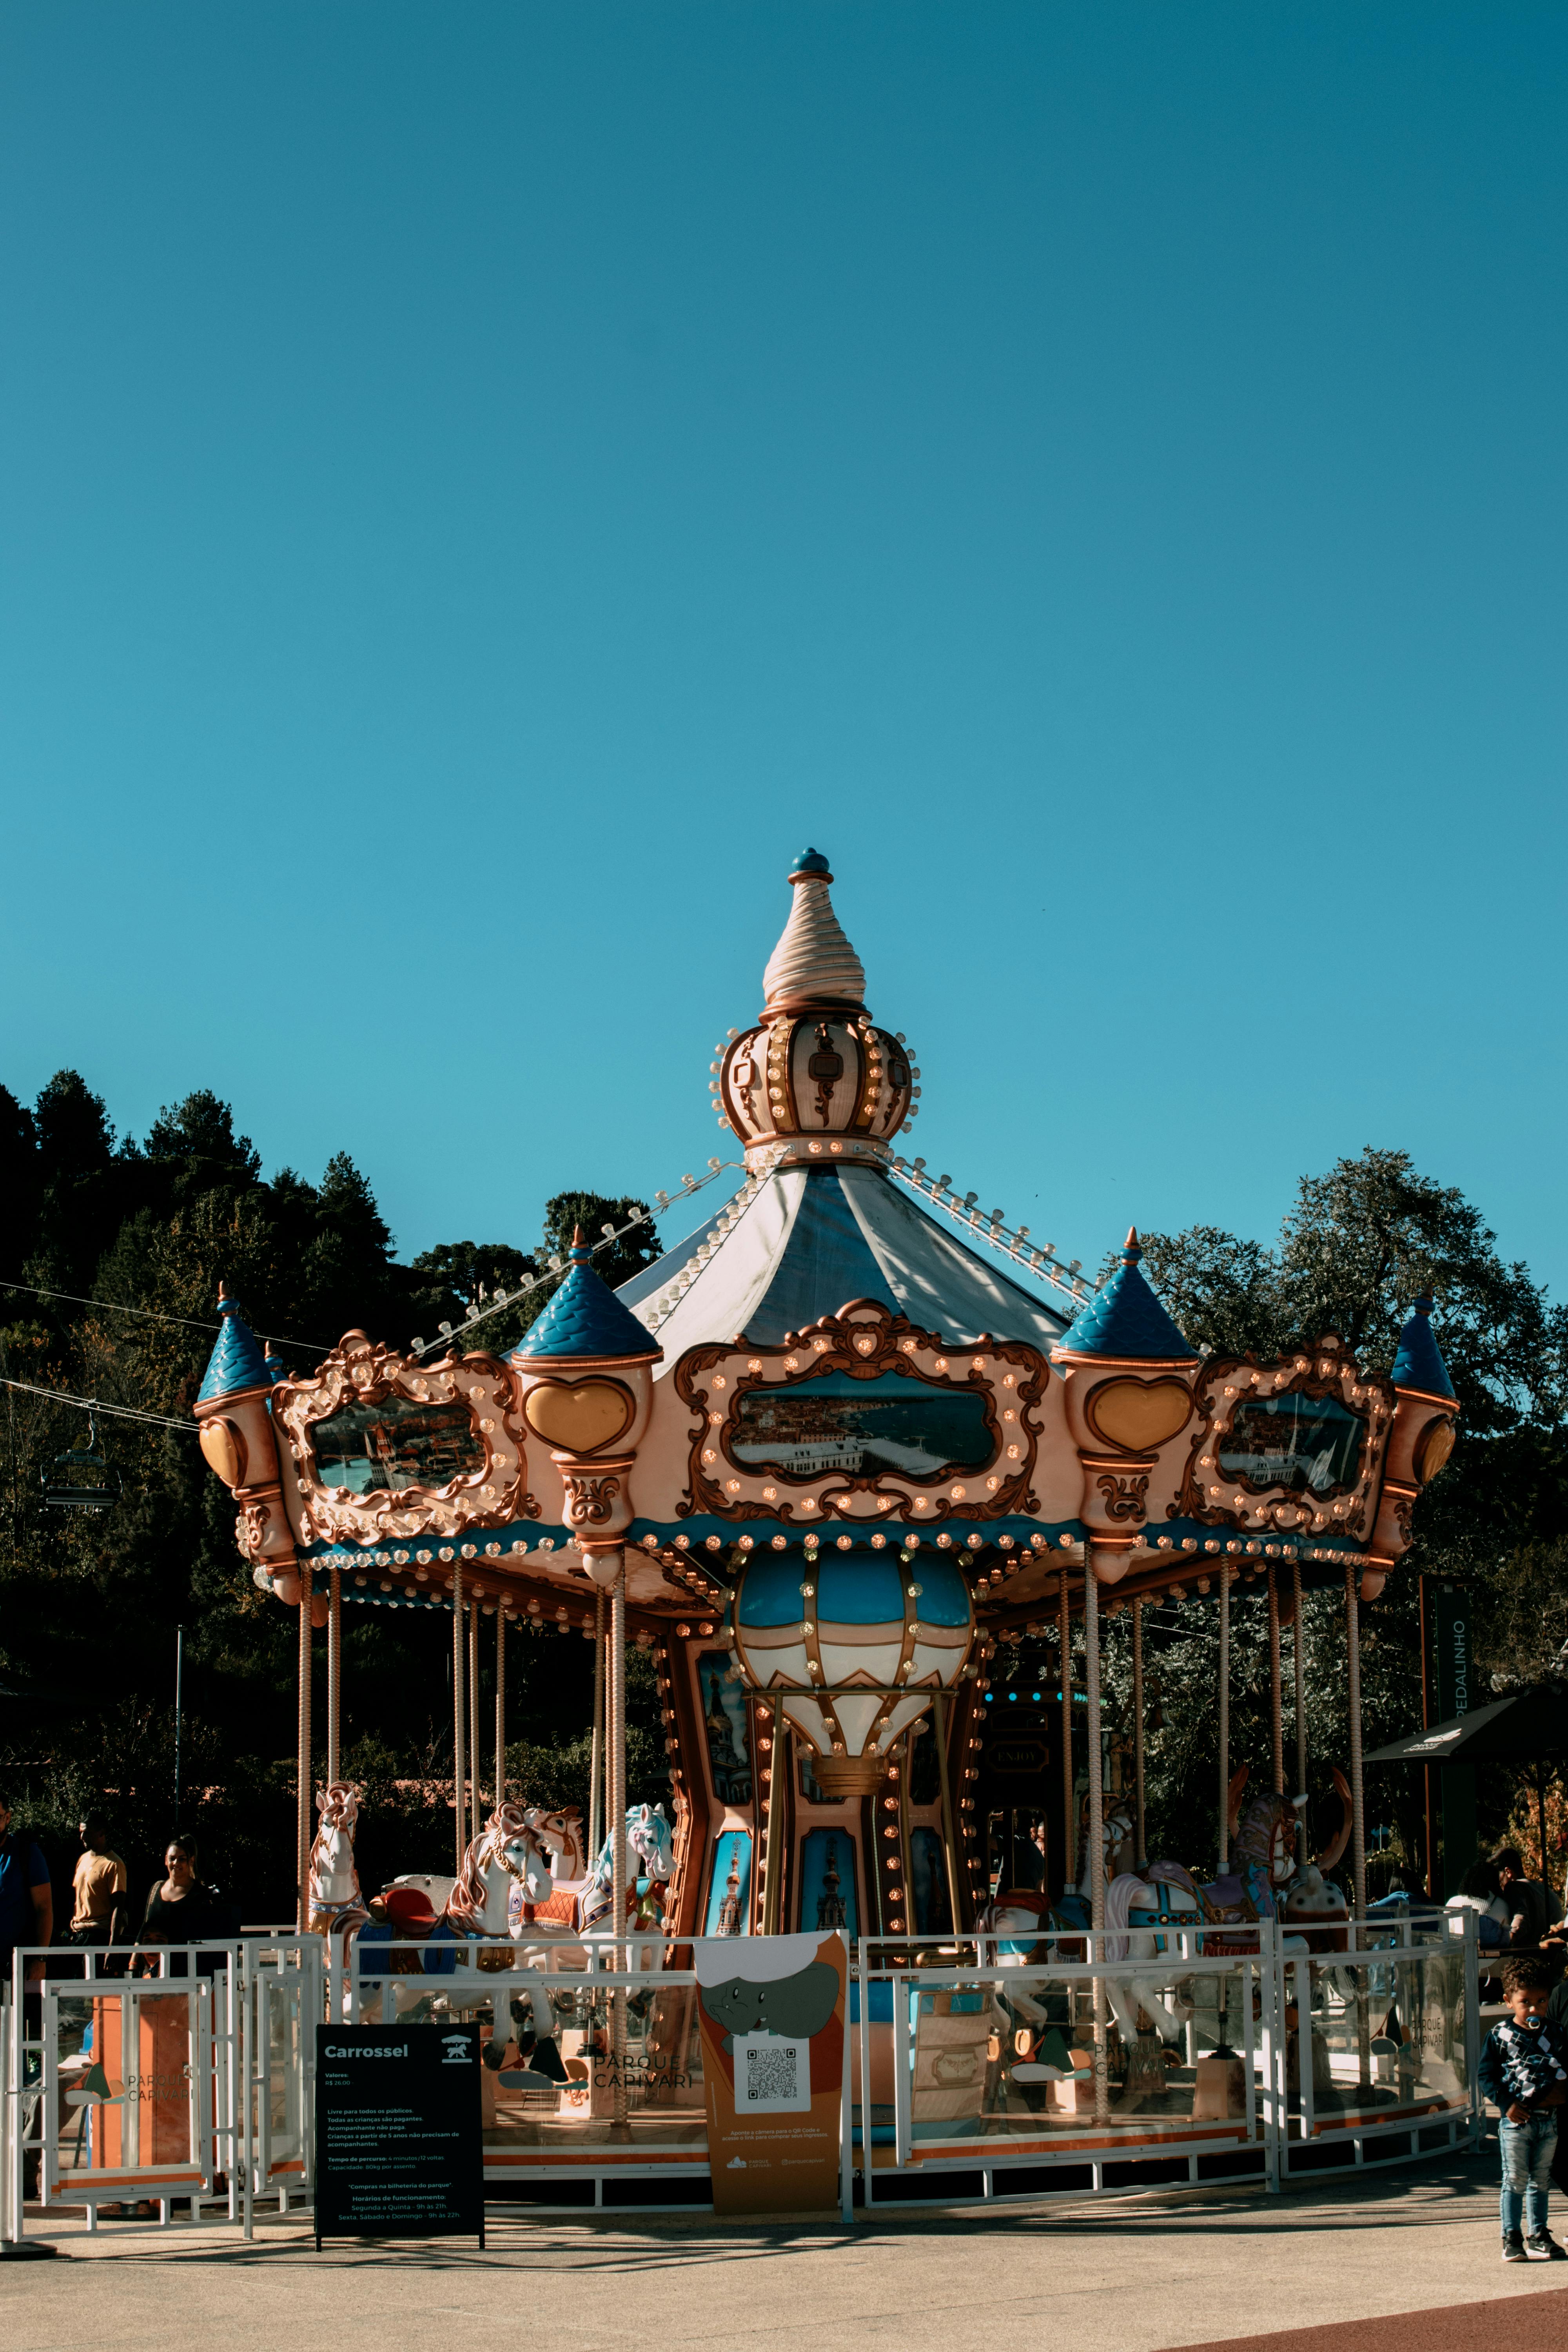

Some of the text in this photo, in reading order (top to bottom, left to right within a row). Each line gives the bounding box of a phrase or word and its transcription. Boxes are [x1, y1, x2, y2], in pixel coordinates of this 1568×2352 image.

[998, 1751, 1036, 1761] ENJOY
[1412, 2018, 1441, 2032] PARQUE
[1094, 2040, 1161, 2057] PARQUE
[1412, 2034, 1445, 2049] CAPIVARI
[325, 2044, 408, 2058] Carrossel
[594, 2056, 681, 2070] PARQUE
[1095, 2058, 1170, 2075] CAPIVARI
[129, 2074, 185, 2087] PARQUE
[594, 2074, 692, 2088] CAPIVARI
[129, 2089, 193, 2102] CAPIVARI
